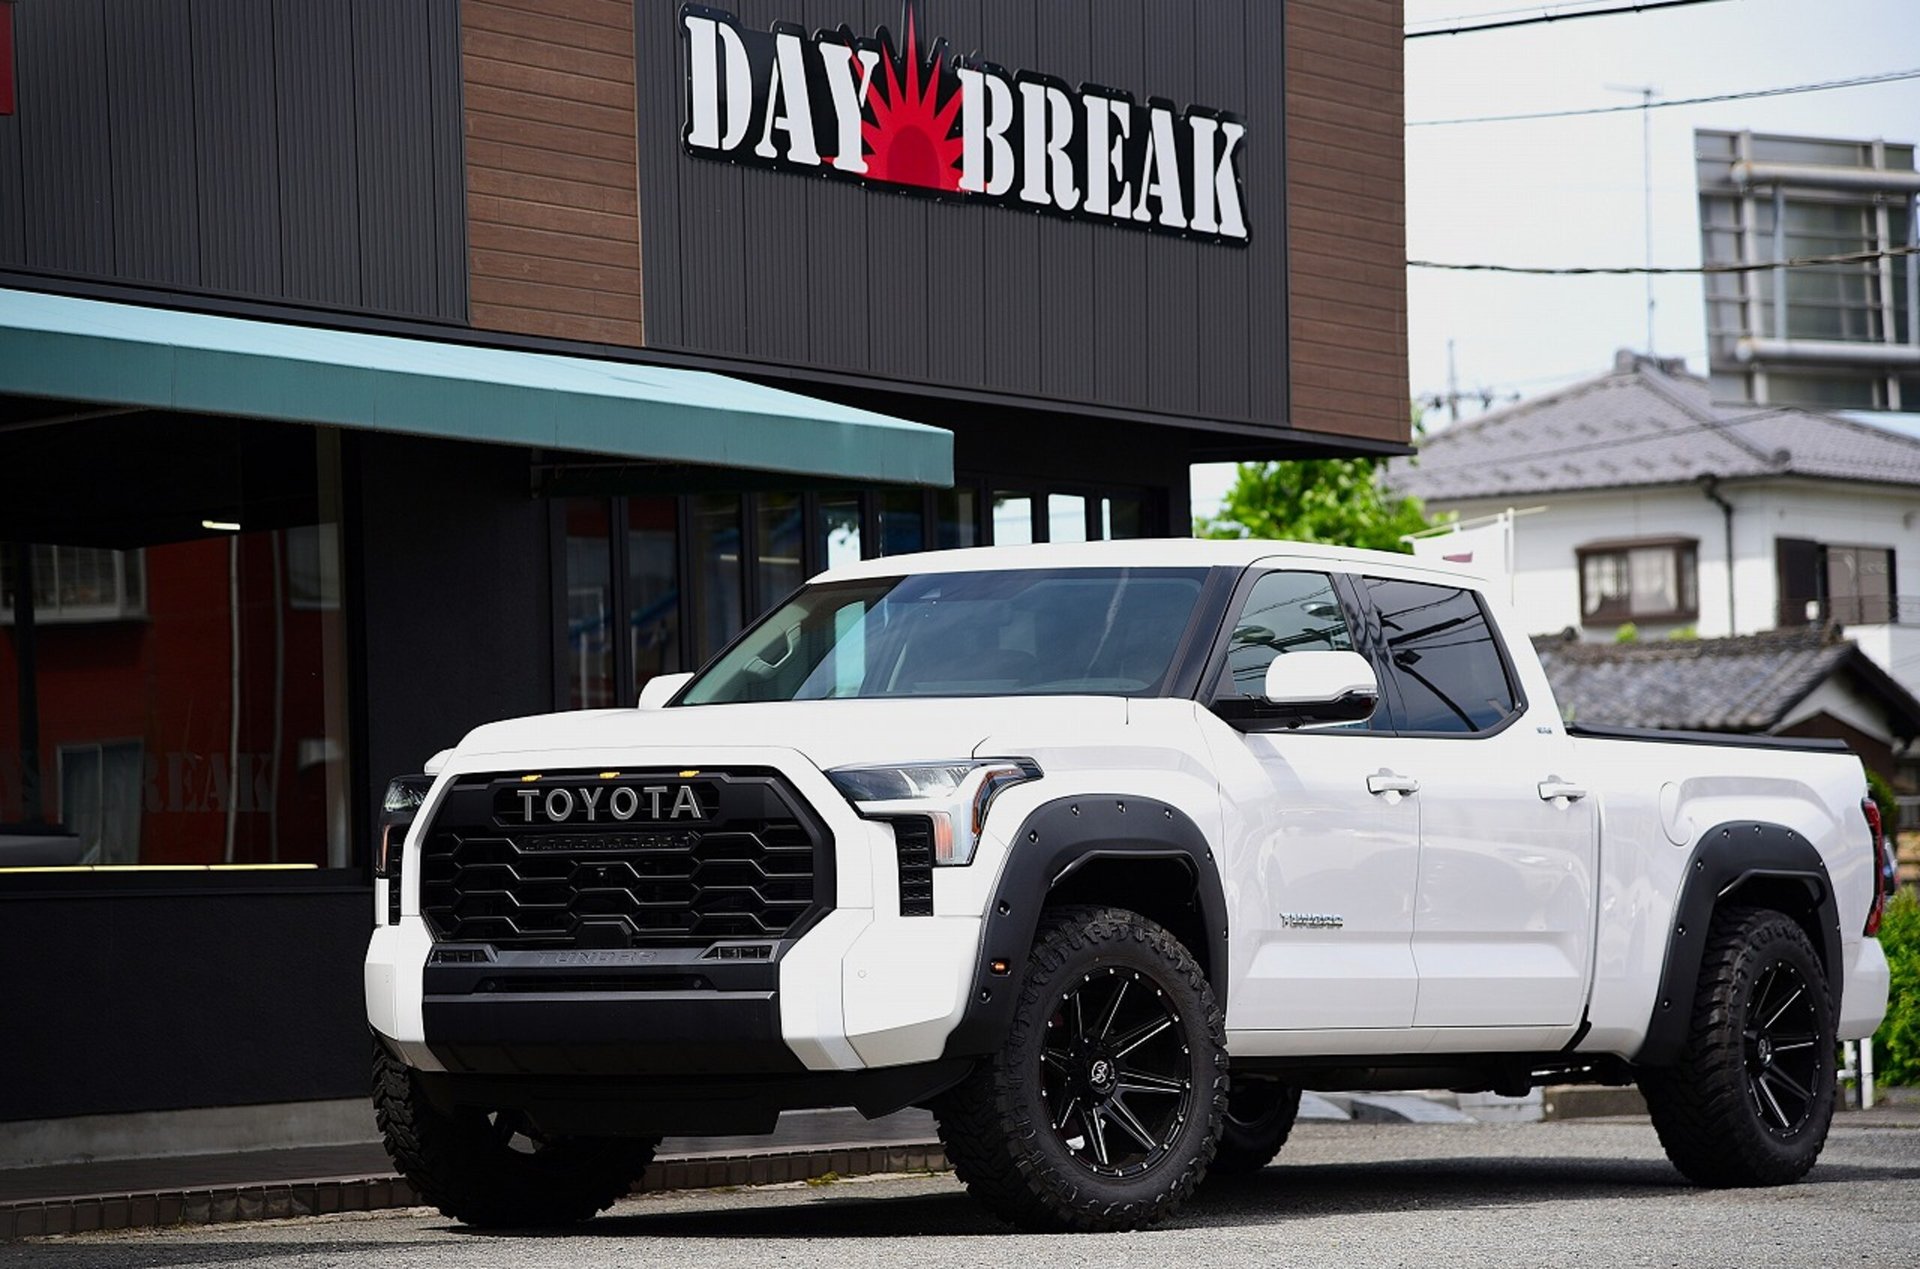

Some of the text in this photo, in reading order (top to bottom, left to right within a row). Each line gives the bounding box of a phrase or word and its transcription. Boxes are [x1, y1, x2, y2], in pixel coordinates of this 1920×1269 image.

[685, 15, 1248, 239] DAY BREAK
[126, 751, 275, 813] REAK
[516, 785, 702, 822] TOYOTA
